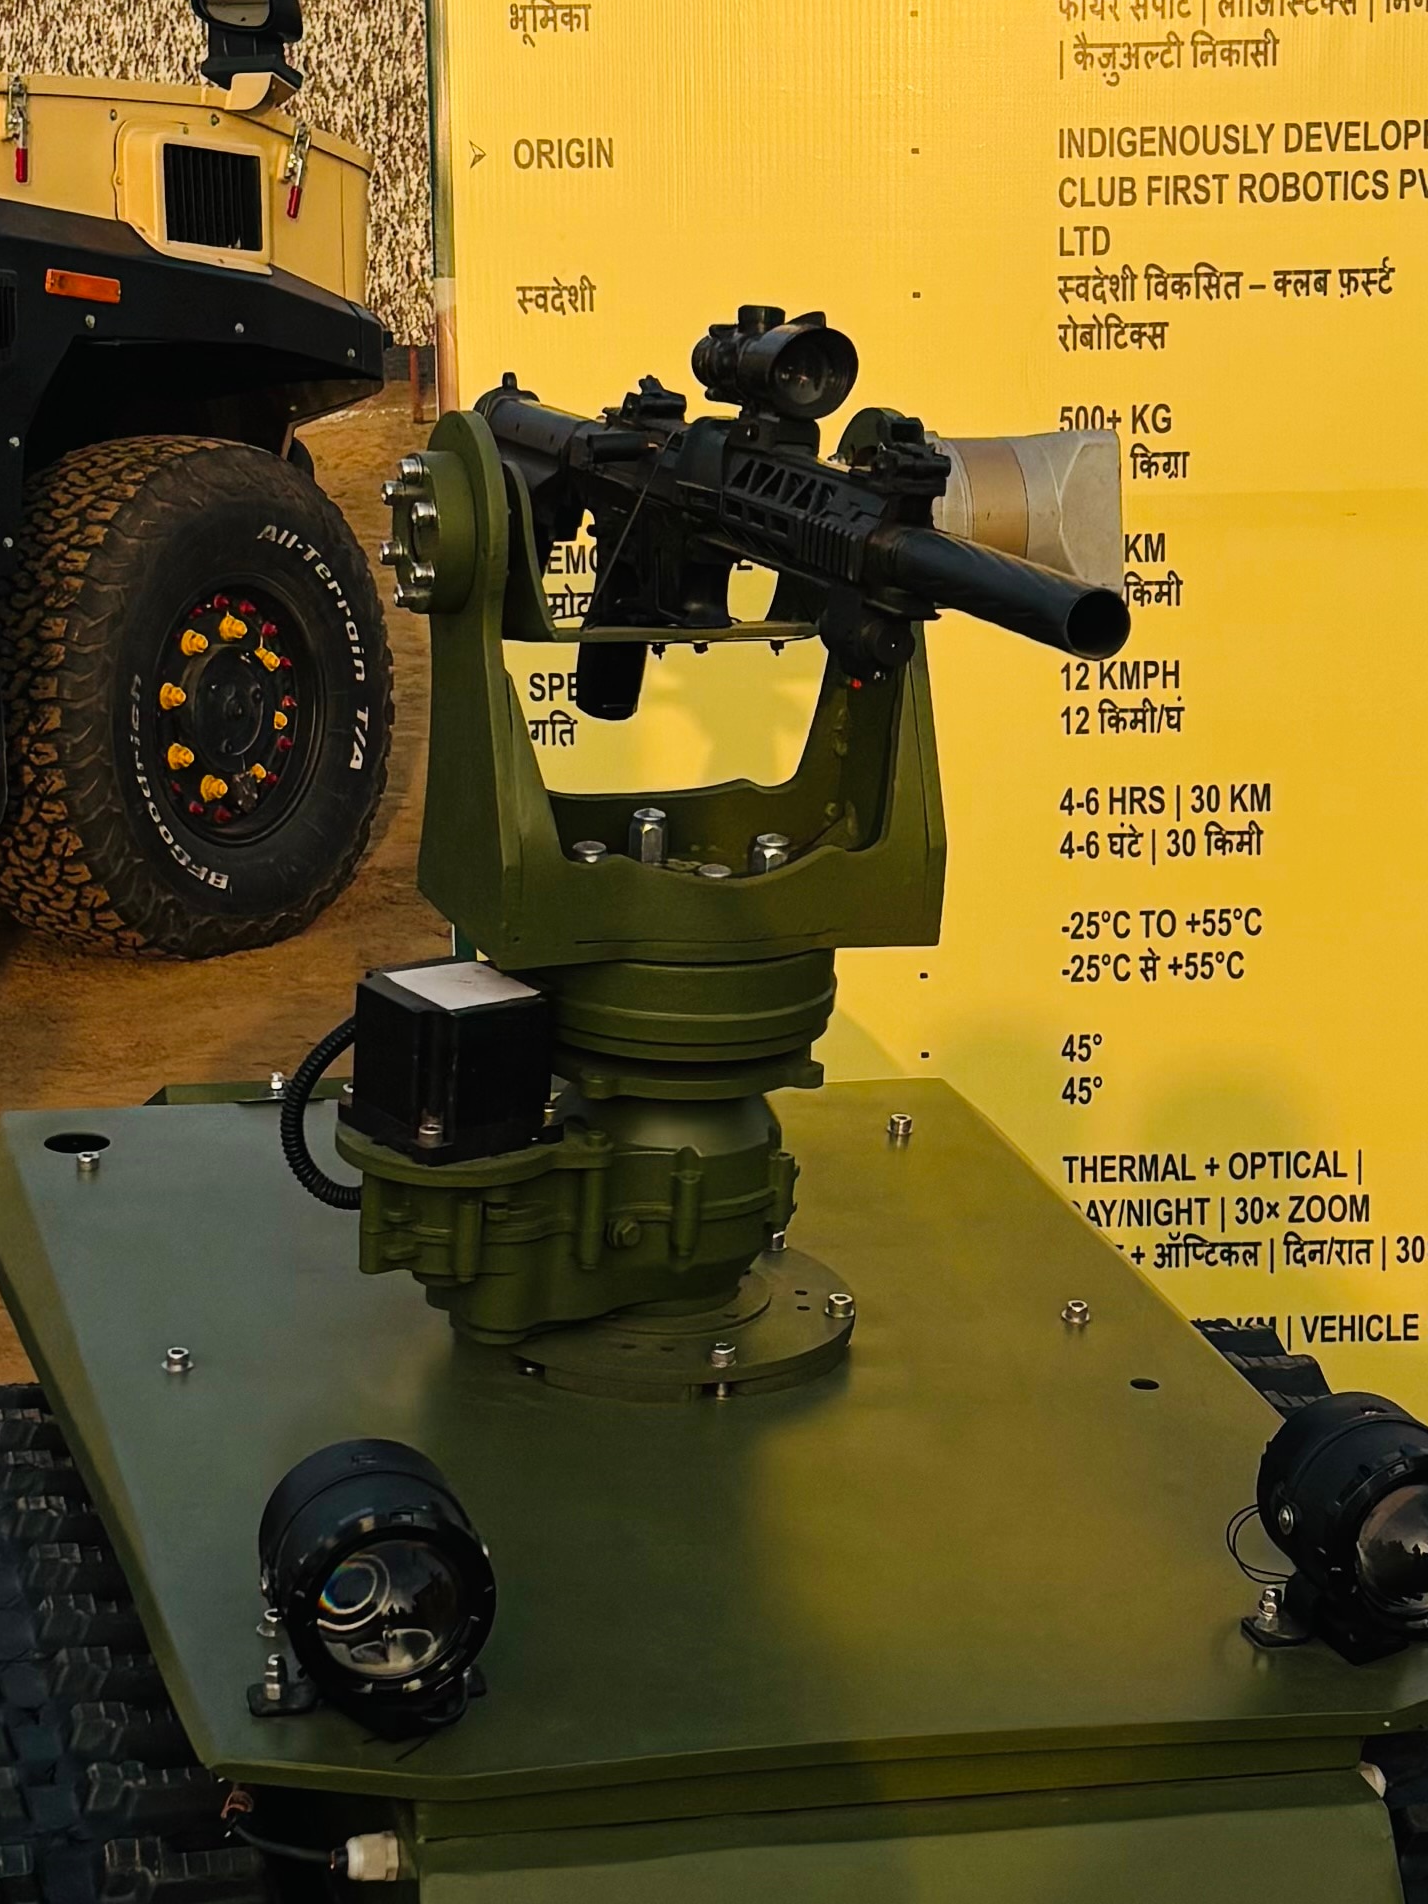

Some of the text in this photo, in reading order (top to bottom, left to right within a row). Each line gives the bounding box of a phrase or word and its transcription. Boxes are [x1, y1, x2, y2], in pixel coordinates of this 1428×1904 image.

[1190, 28, 1280, 69] निकासी
[513, 137, 615, 170] ORIGIN
[1058, 123, 1276, 159] INDIGENOUSLY
[1058, 176, 1138, 209] CLUB
[1146, 173, 1229, 206] FIRST
[1238, 169, 1390, 204] ROBOTICS
[1058, 225, 1111, 257] LTD
[515, 275, 597, 315] स्वदेशी
[1057, 264, 1138, 305] स्वदेशी
[1144, 262, 1244, 302] विकसित
[1273, 268, 1331, 299] क्लब
[1057, 312, 1170, 353] रोबोटिक्स
[1059, 403, 1173, 434] 500+ KG
[1130, 443, 1190, 479] किग्रा
[1124, 533, 1166, 563] KM
[1124, 570, 1184, 607] किमी
[256, 524, 370, 771] All-Terrain T/A
[528, 672, 577, 702] SPE
[1060, 660, 1181, 691] 12 KMPH
[528, 709, 578, 747] गति
[1060, 706, 1090, 735] 12
[1059, 787, 1100, 816] 4-6
[1108, 785, 1166, 815] HRS
[1190, 783, 1221, 814] 30
[1229, 783, 1272, 812] KM
[1059, 830, 1100, 859] 4-6
[1107, 822, 1144, 859] घंटे
[1166, 828, 1196, 857] 30
[1204, 820, 1264, 857] किमी
[1060, 907, 1263, 940] -25°C TO +55°C
[1060, 948, 1245, 983] -25°C से +55°C
[1061, 1033, 1103, 1062] 45°
[1061, 1076, 1103, 1105] 45°
[1062, 1153, 1196, 1184] THERMAL
[1228, 1150, 1348, 1180] OPTICAL
[1072, 1197, 1210, 1228] AY/NIGHT
[1288, 1194, 1370, 1224] ZOOM
[1153, 1231, 1262, 1269] ऑप्टिकल
[1283, 1231, 1374, 1267] दिन/रात
[1300, 1314, 1419, 1343] VEHICLE
